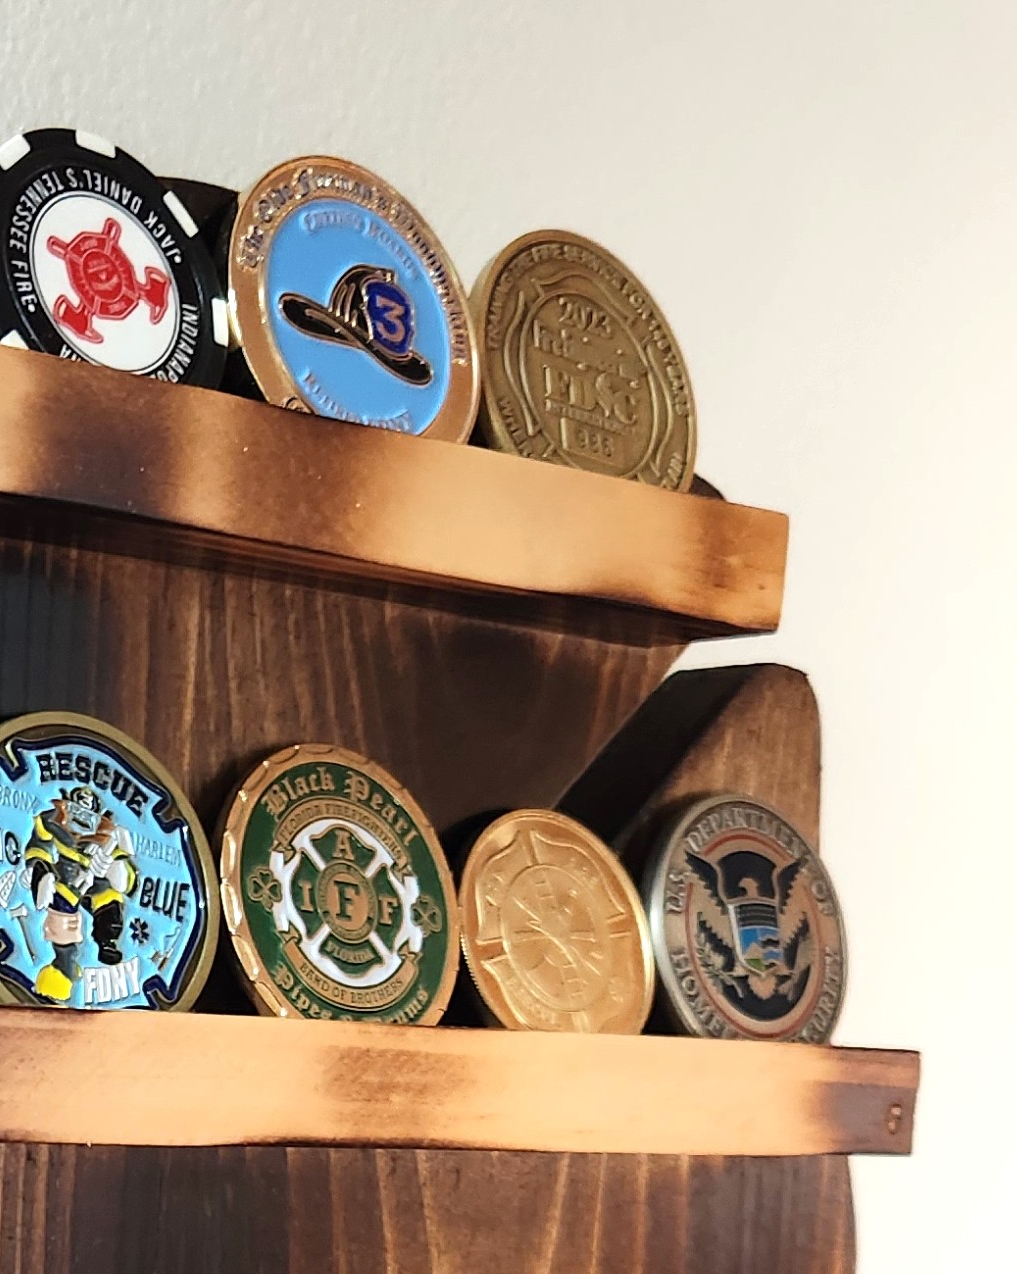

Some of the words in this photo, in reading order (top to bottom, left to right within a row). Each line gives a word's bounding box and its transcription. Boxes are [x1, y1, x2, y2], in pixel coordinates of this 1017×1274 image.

[9, 171, 65, 254] TENNESSEE
[143, 211, 182, 258] JACK
[10, 259, 38, 308] FIRE
[376, 293, 406, 343] 3
[35, 752, 150, 818] RESCUE
[260, 766, 336, 817] Black
[343, 770, 419, 847] Pearl
[333, 830, 355, 860] A
[139, 876, 191, 924] BLUE
[297, 880, 314, 913] I
[333, 879, 362, 923] F
[378, 895, 399, 926] F
[83, 956, 141, 1005] FDNY
[299, 963, 331, 993] BAND
[333, 986, 346, 1001] OF
